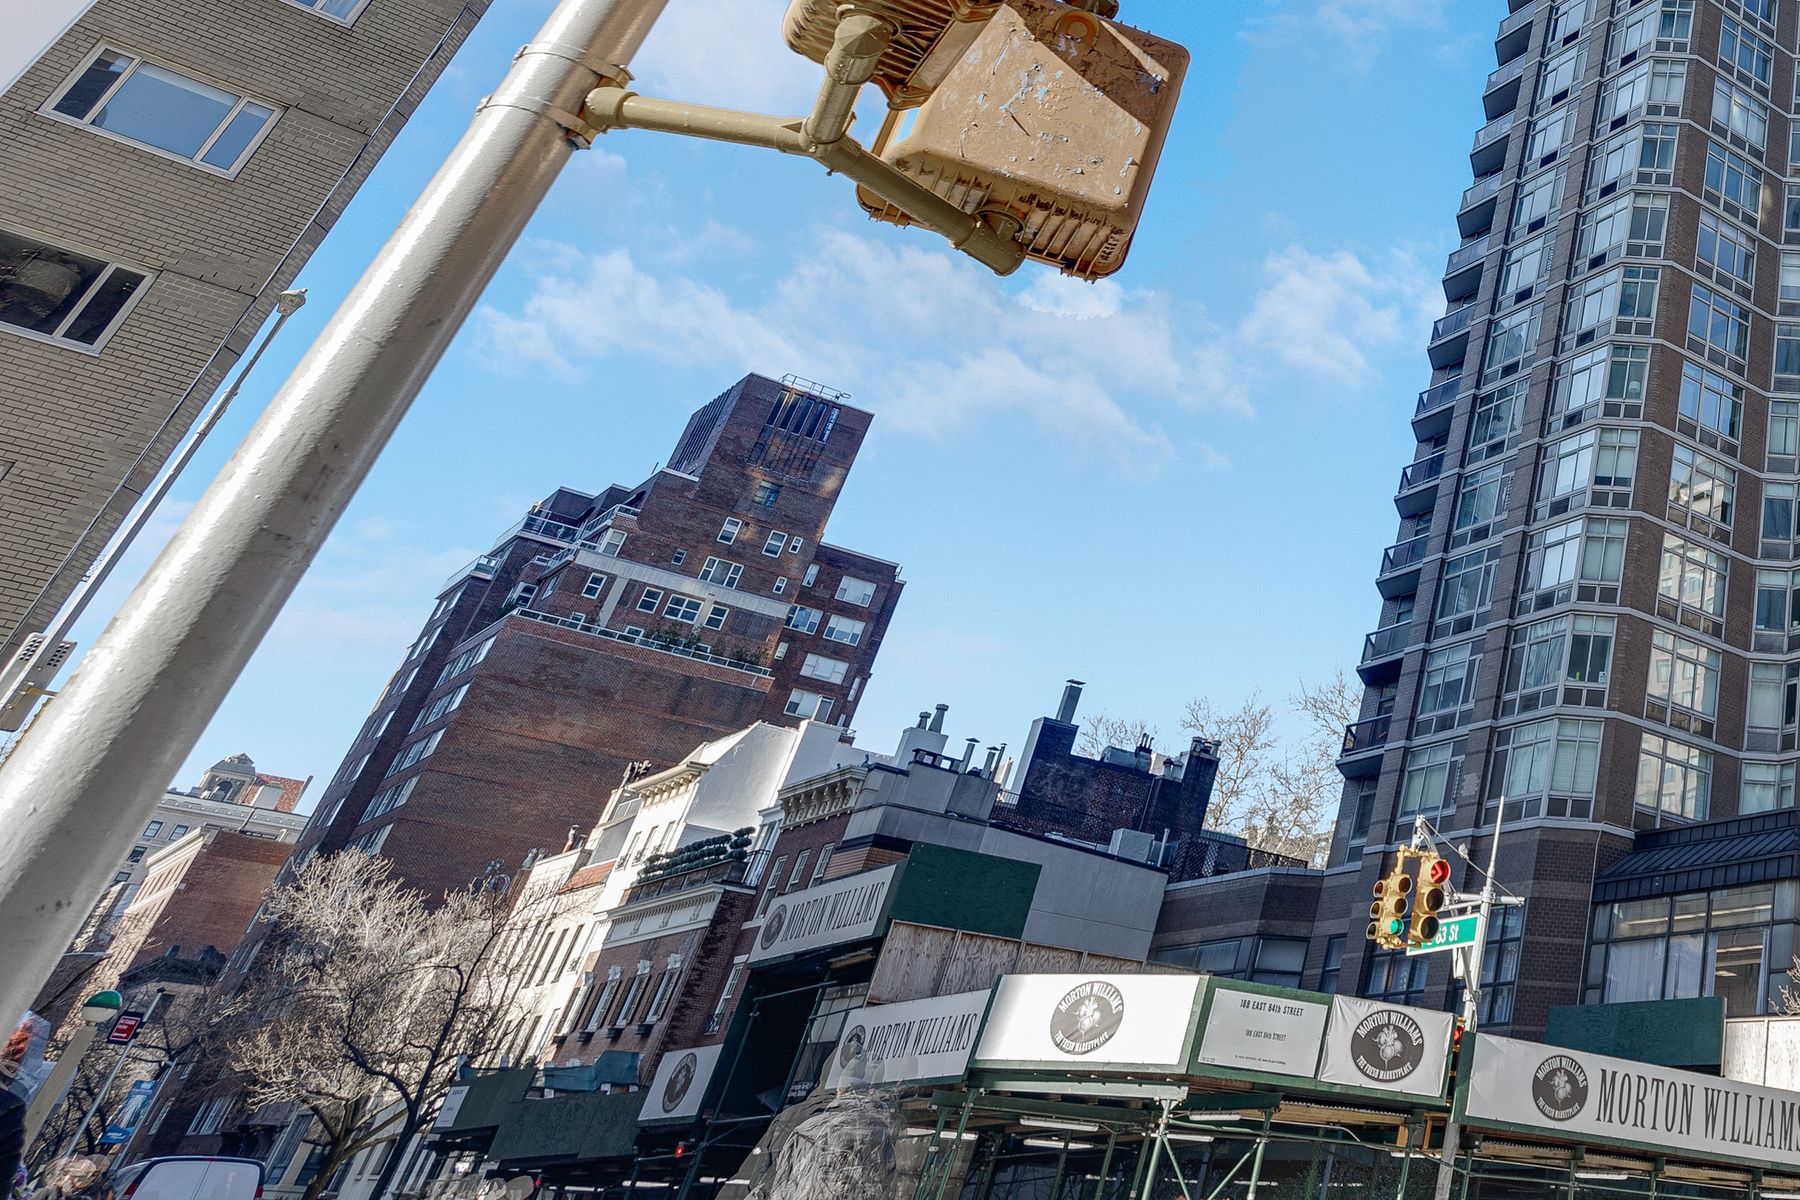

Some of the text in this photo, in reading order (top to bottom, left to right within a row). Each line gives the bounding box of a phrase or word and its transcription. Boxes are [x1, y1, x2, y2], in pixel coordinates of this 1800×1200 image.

[781, 895, 832, 942] MORTON
[824, 881, 886, 932] WILLIAMS
[1448, 924, 1460, 942] St
[1058, 982, 1123, 1014] MORTON WILLIAMS
[1251, 1000, 1267, 1012] EAST
[1282, 1005, 1304, 1017] STREET
[866, 1021, 916, 1061] MORTON
[910, 1012, 978, 1057] WILLIAMS
[1356, 1011, 1423, 1046] MORTON WILLIAMS
[1536, 1056, 1587, 1088] MORTON WILLIAMS
[1596, 1068, 1696, 1136] MORTON
